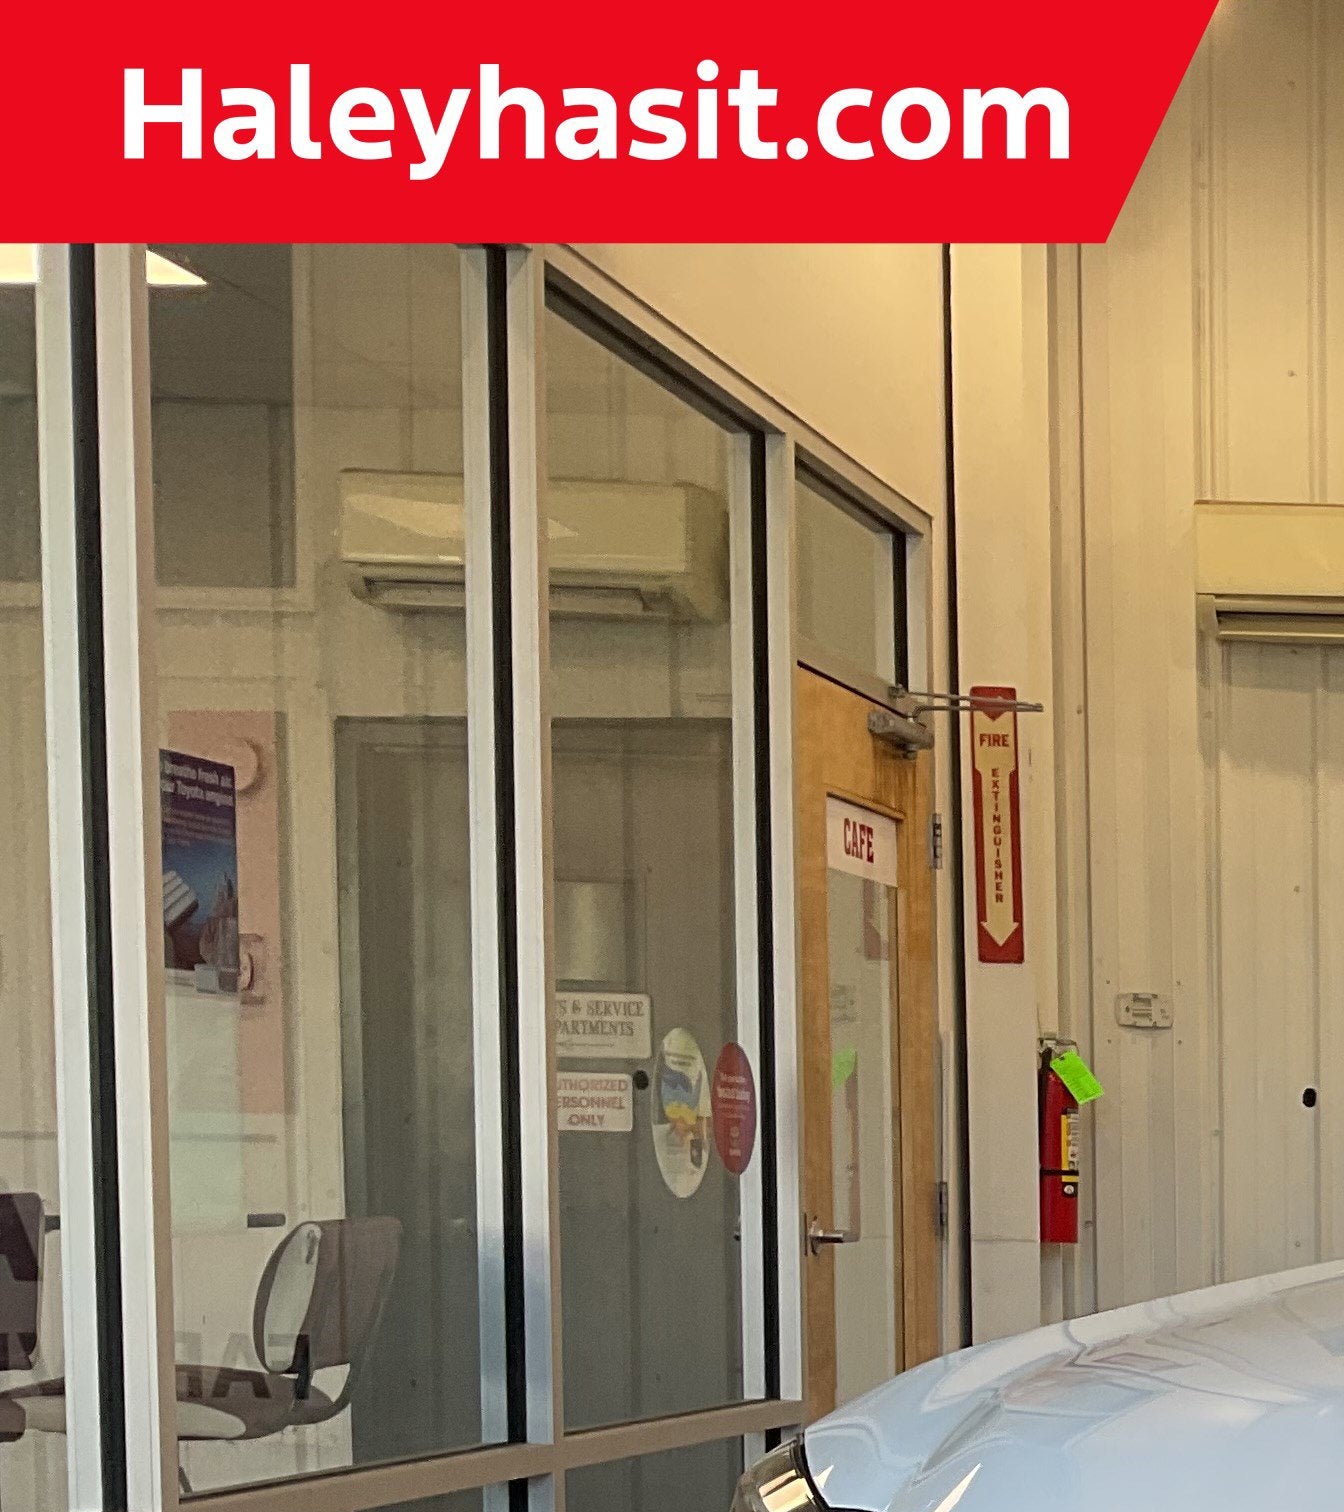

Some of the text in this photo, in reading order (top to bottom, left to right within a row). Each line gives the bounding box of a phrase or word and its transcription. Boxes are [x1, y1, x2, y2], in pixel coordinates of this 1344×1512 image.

[979, 733, 1010, 748] FIRE
[843, 817, 875, 864] CAFE
[991, 768, 1004, 903] EXTINGUISHER
[587, 1000, 645, 1018] SERVICE
[568, 1113, 606, 1127] ONLY
